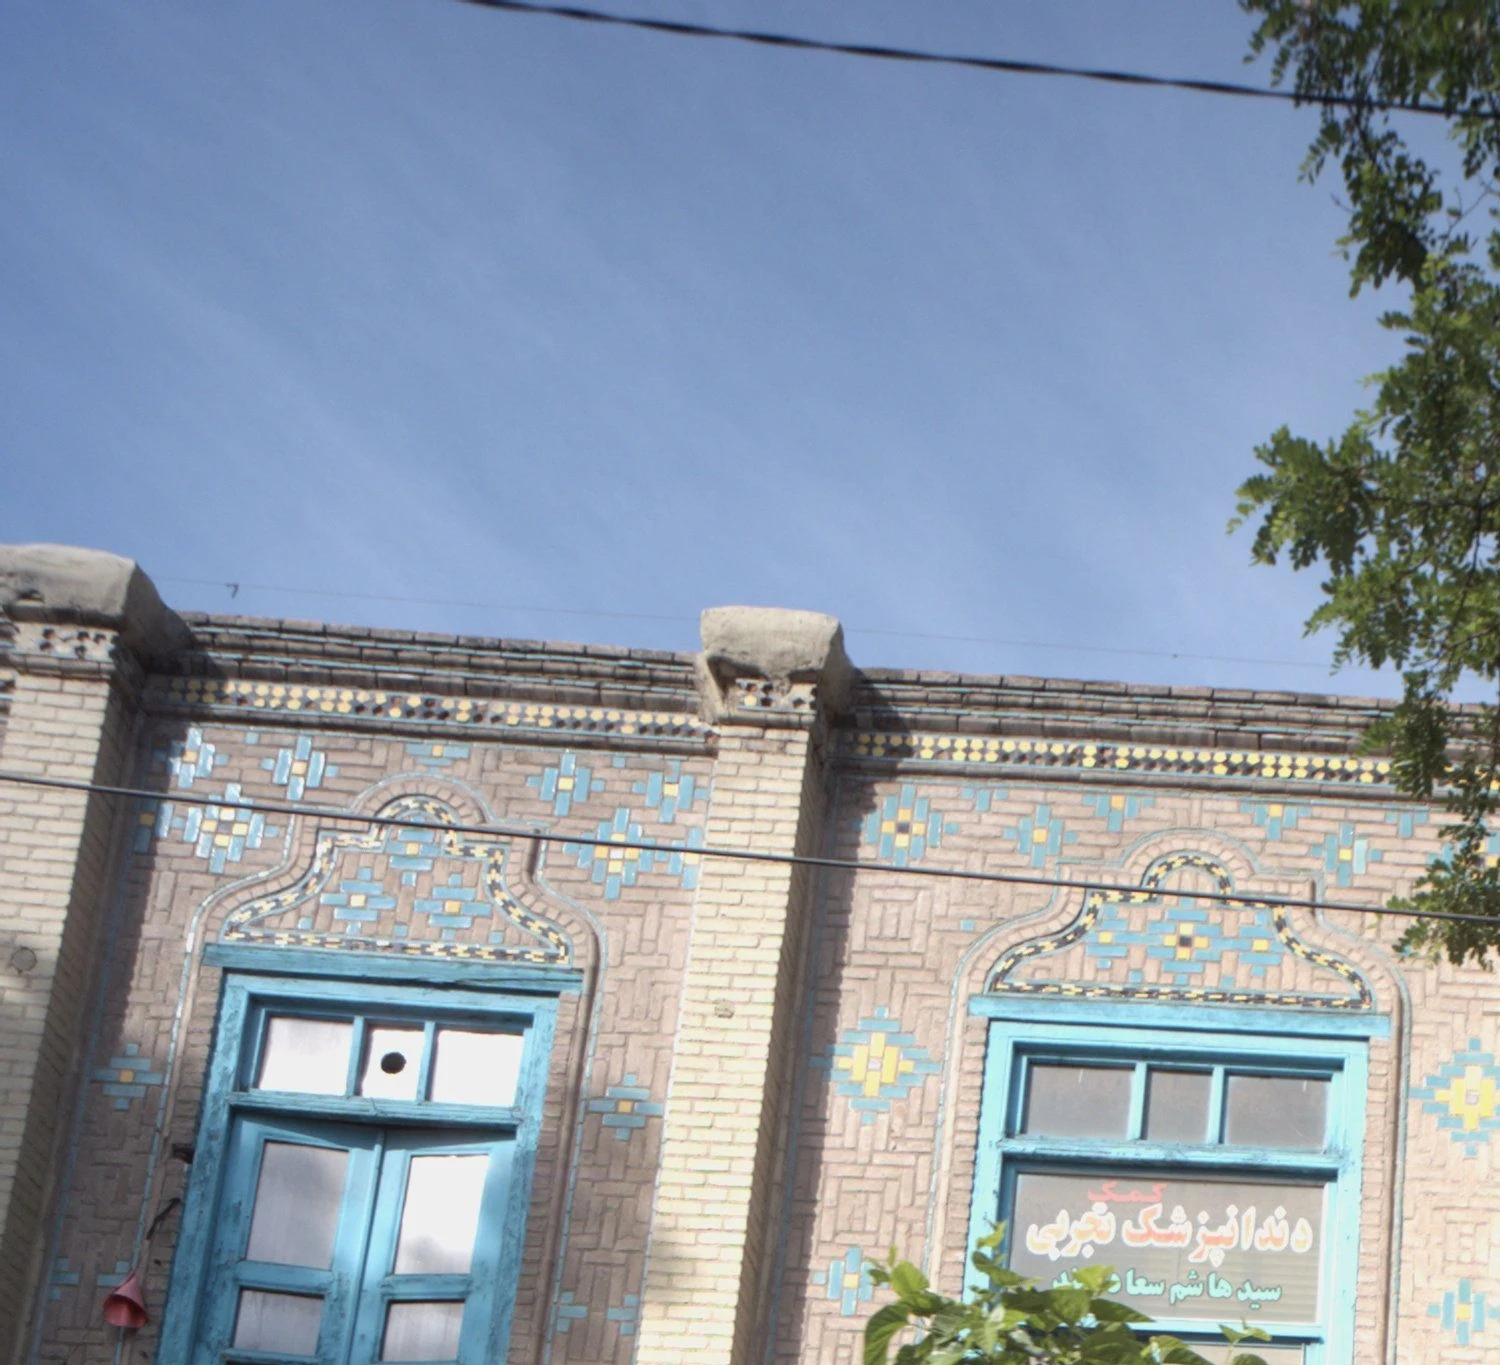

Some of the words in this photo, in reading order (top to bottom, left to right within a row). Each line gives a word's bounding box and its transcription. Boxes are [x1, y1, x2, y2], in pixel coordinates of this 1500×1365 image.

[1088, 1181, 1168, 1203] کمک
[1025, 1202, 1117, 1260] تجربی
[1121, 1203, 1313, 1266] دندانپزشک
[1236, 1277, 1283, 1309] سید
